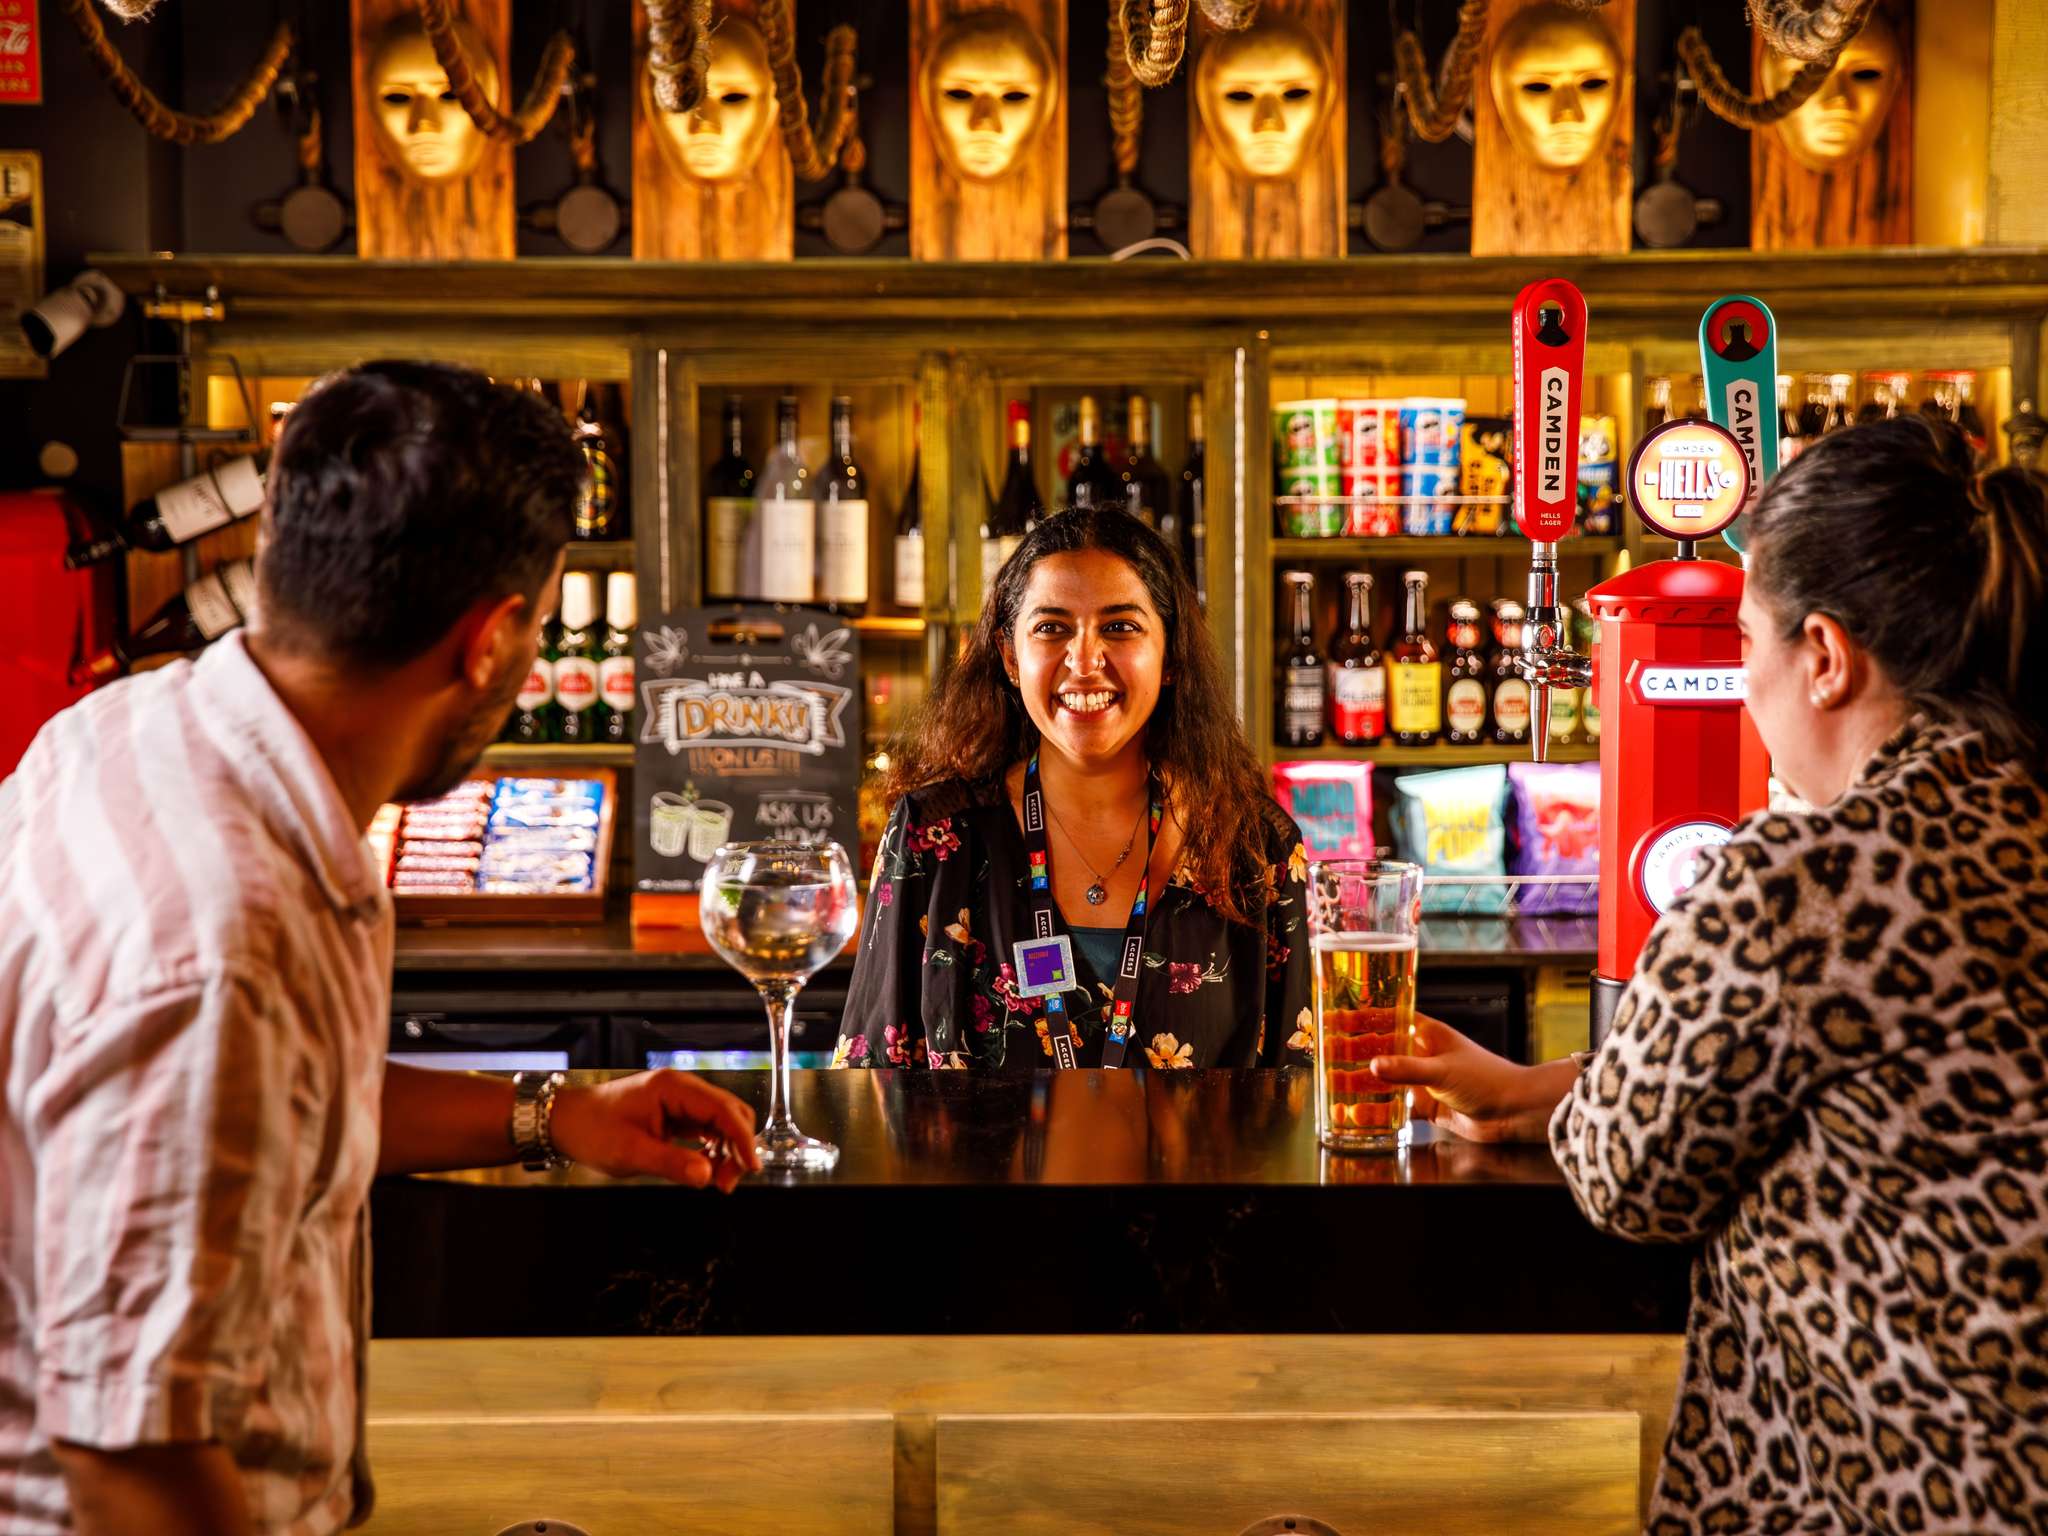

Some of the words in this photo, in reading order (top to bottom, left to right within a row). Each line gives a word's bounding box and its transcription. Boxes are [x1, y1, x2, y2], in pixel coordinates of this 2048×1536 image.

[1544, 377, 1563, 491] CAMDEN
[1658, 459, 1719, 500] HELLS
[1646, 677, 1744, 691] CAMDE
[755, 801, 799, 825] ASK
[802, 802, 834, 828] US
[1126, 943, 1136, 972] ACCESS
[1060, 1042, 1071, 1069] ACCES
